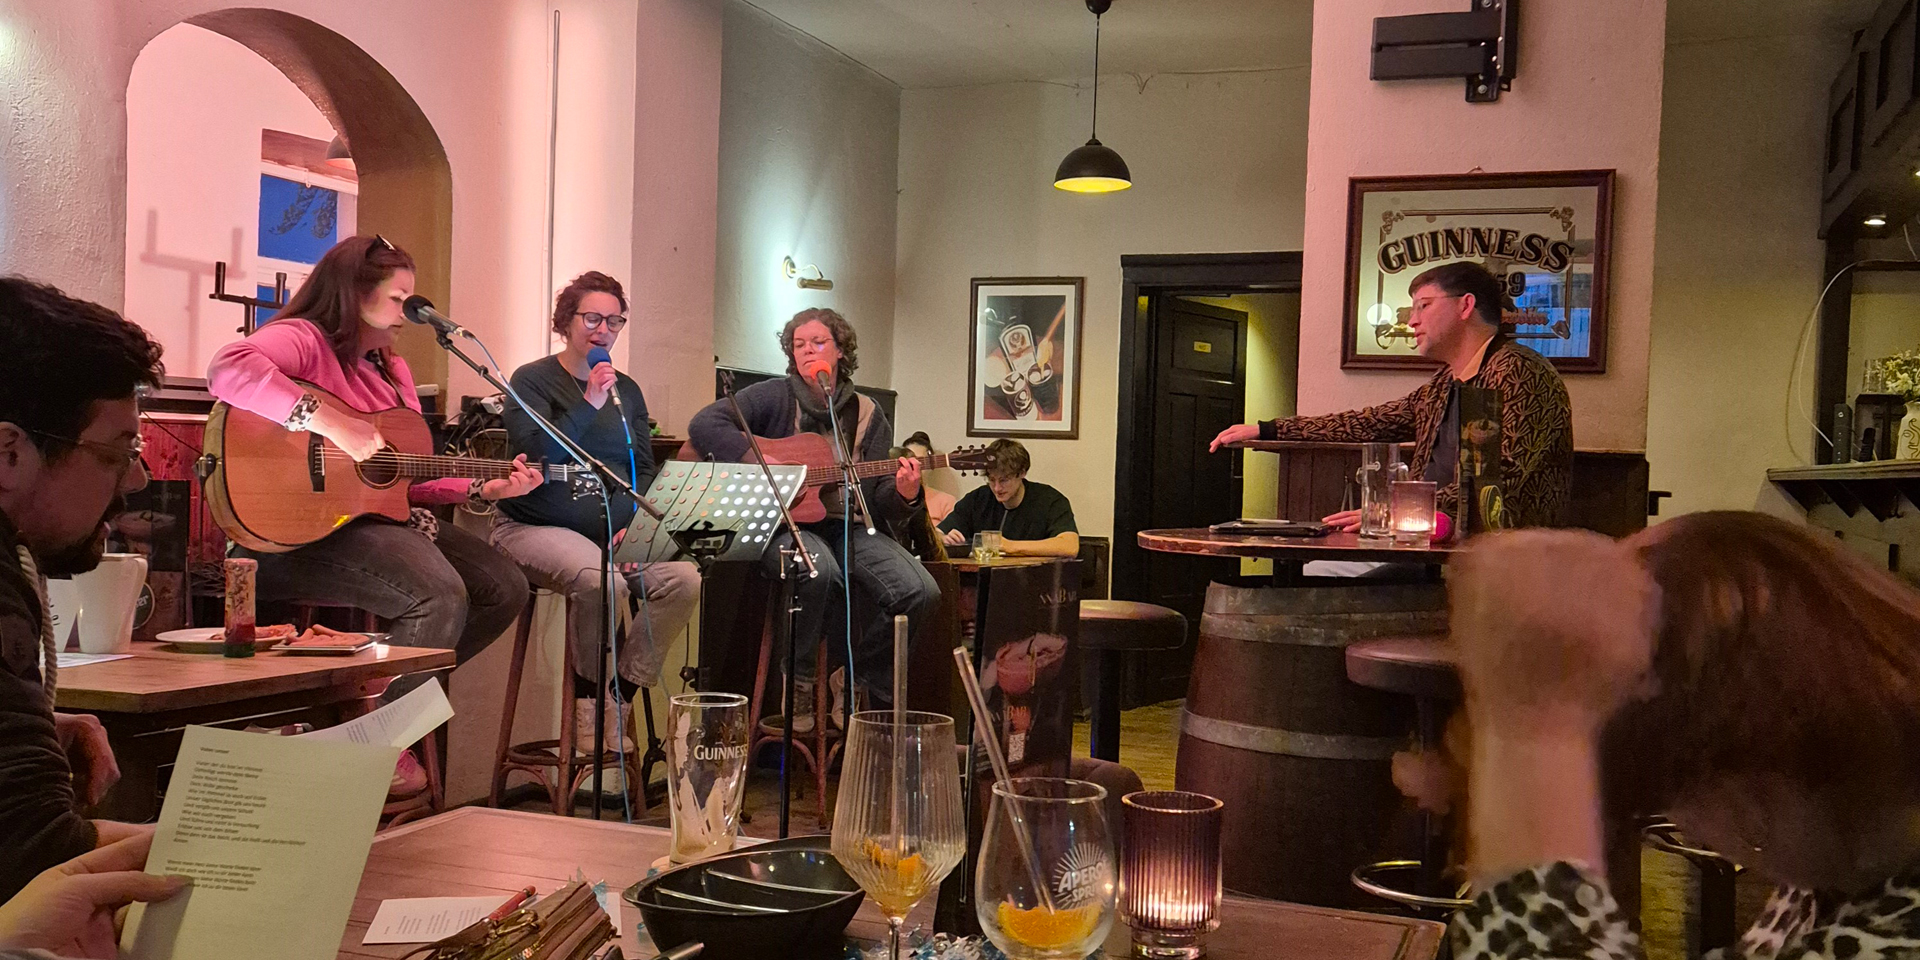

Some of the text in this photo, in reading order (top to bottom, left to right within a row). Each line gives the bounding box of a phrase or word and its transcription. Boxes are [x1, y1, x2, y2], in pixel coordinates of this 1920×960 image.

[1377, 227, 1575, 274] GUINNESS
[1494, 271, 1526, 298] 59
[693, 744, 748, 761] GUINNESS
[1071, 884, 1096, 902] SPRI
